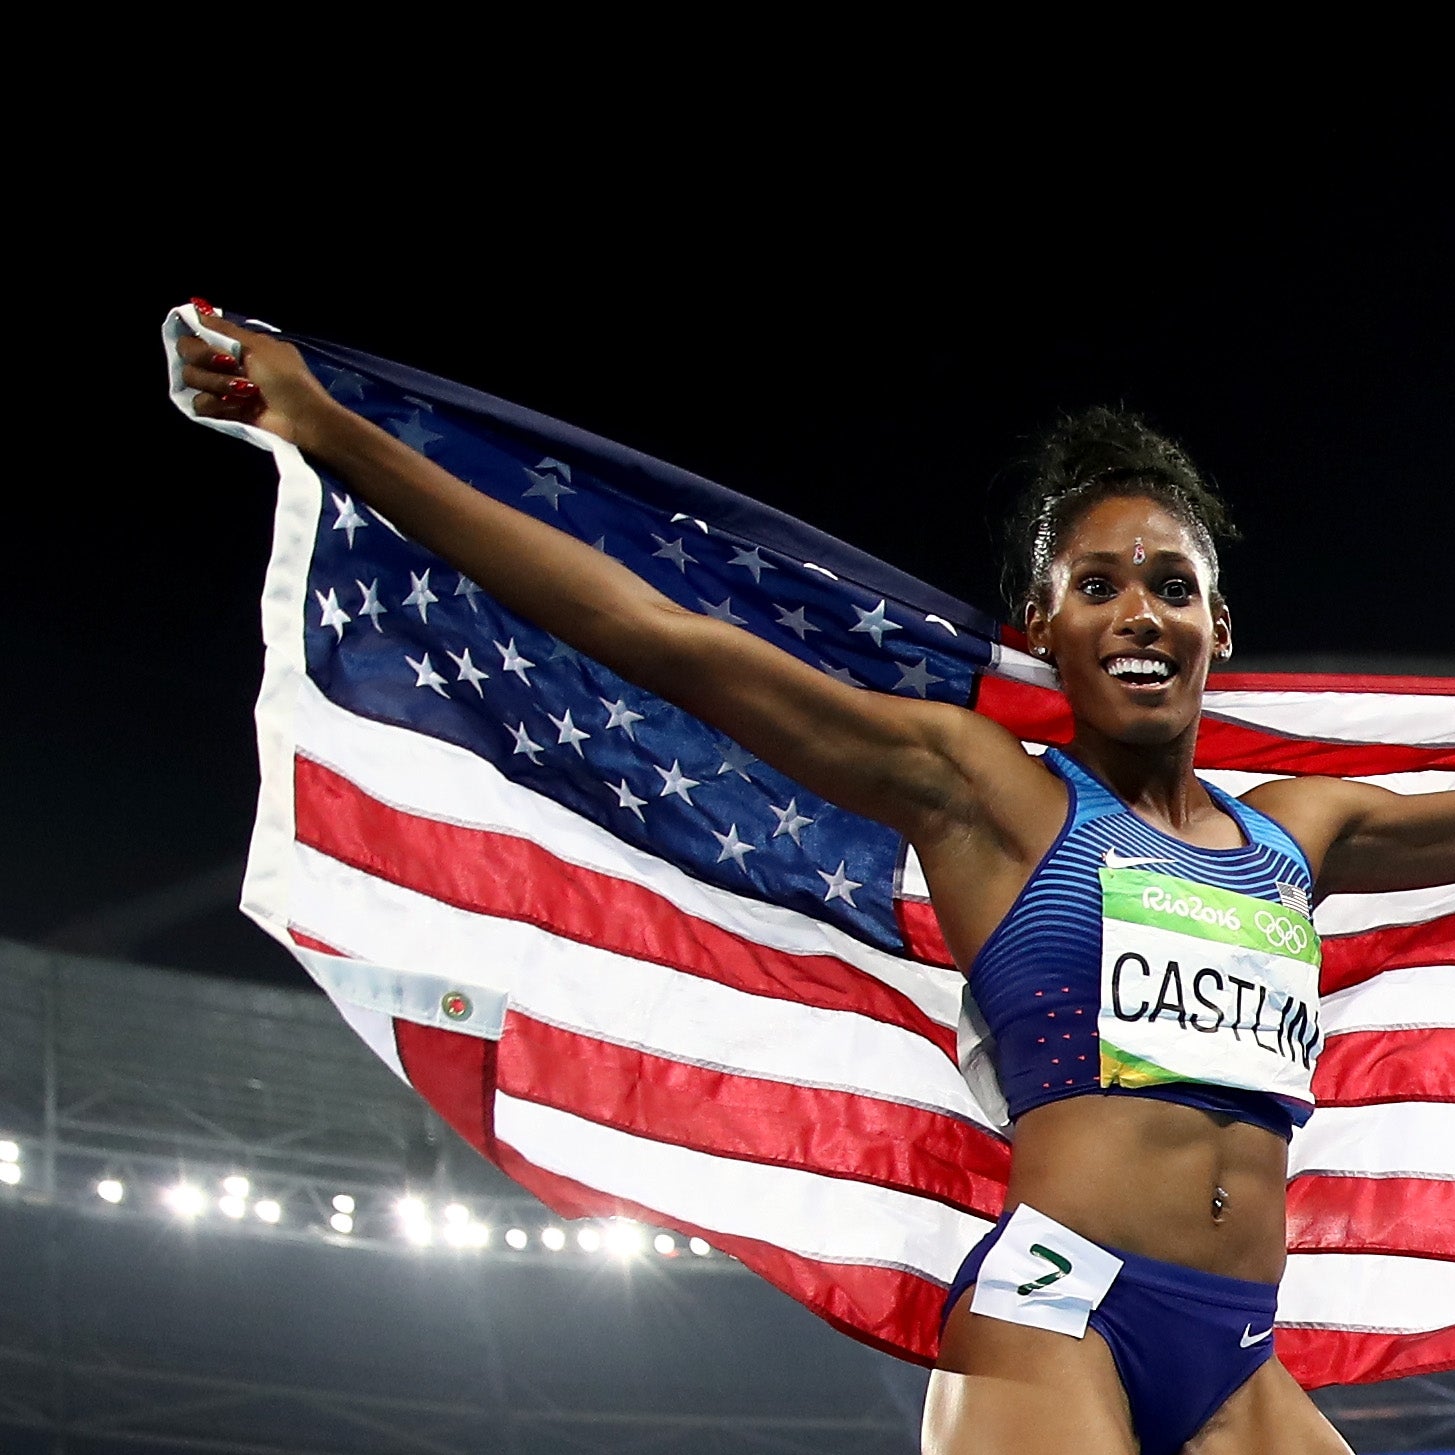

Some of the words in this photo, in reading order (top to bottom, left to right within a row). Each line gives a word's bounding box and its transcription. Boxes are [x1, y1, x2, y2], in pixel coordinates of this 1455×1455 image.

[1142, 886, 1241, 931] Rio2016
[1111, 951, 1320, 1071] CASTLIN
[1017, 1243, 1072, 1296] 7
